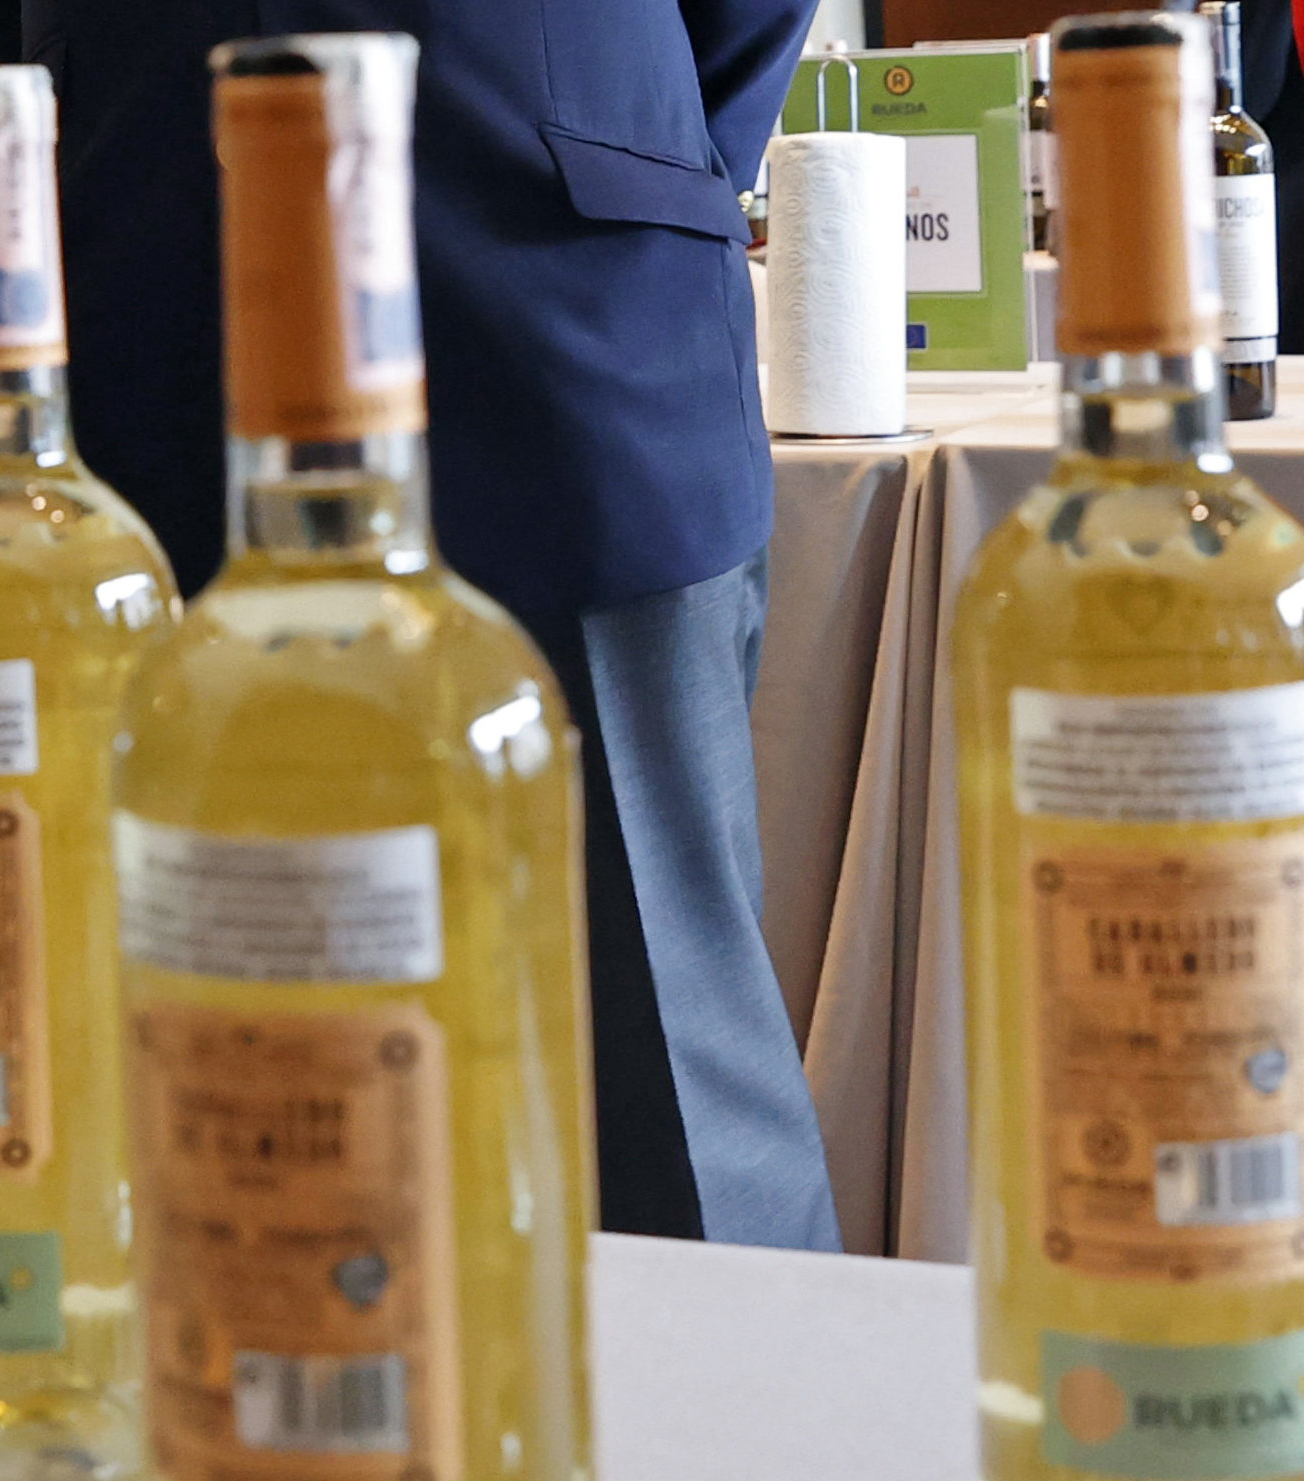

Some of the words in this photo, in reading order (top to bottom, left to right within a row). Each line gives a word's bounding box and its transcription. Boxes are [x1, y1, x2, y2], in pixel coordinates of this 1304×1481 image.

[871, 102, 928, 116] RUEDA
[905, 212, 950, 242] NOS
[1132, 1386, 1298, 1434] RUEDA
